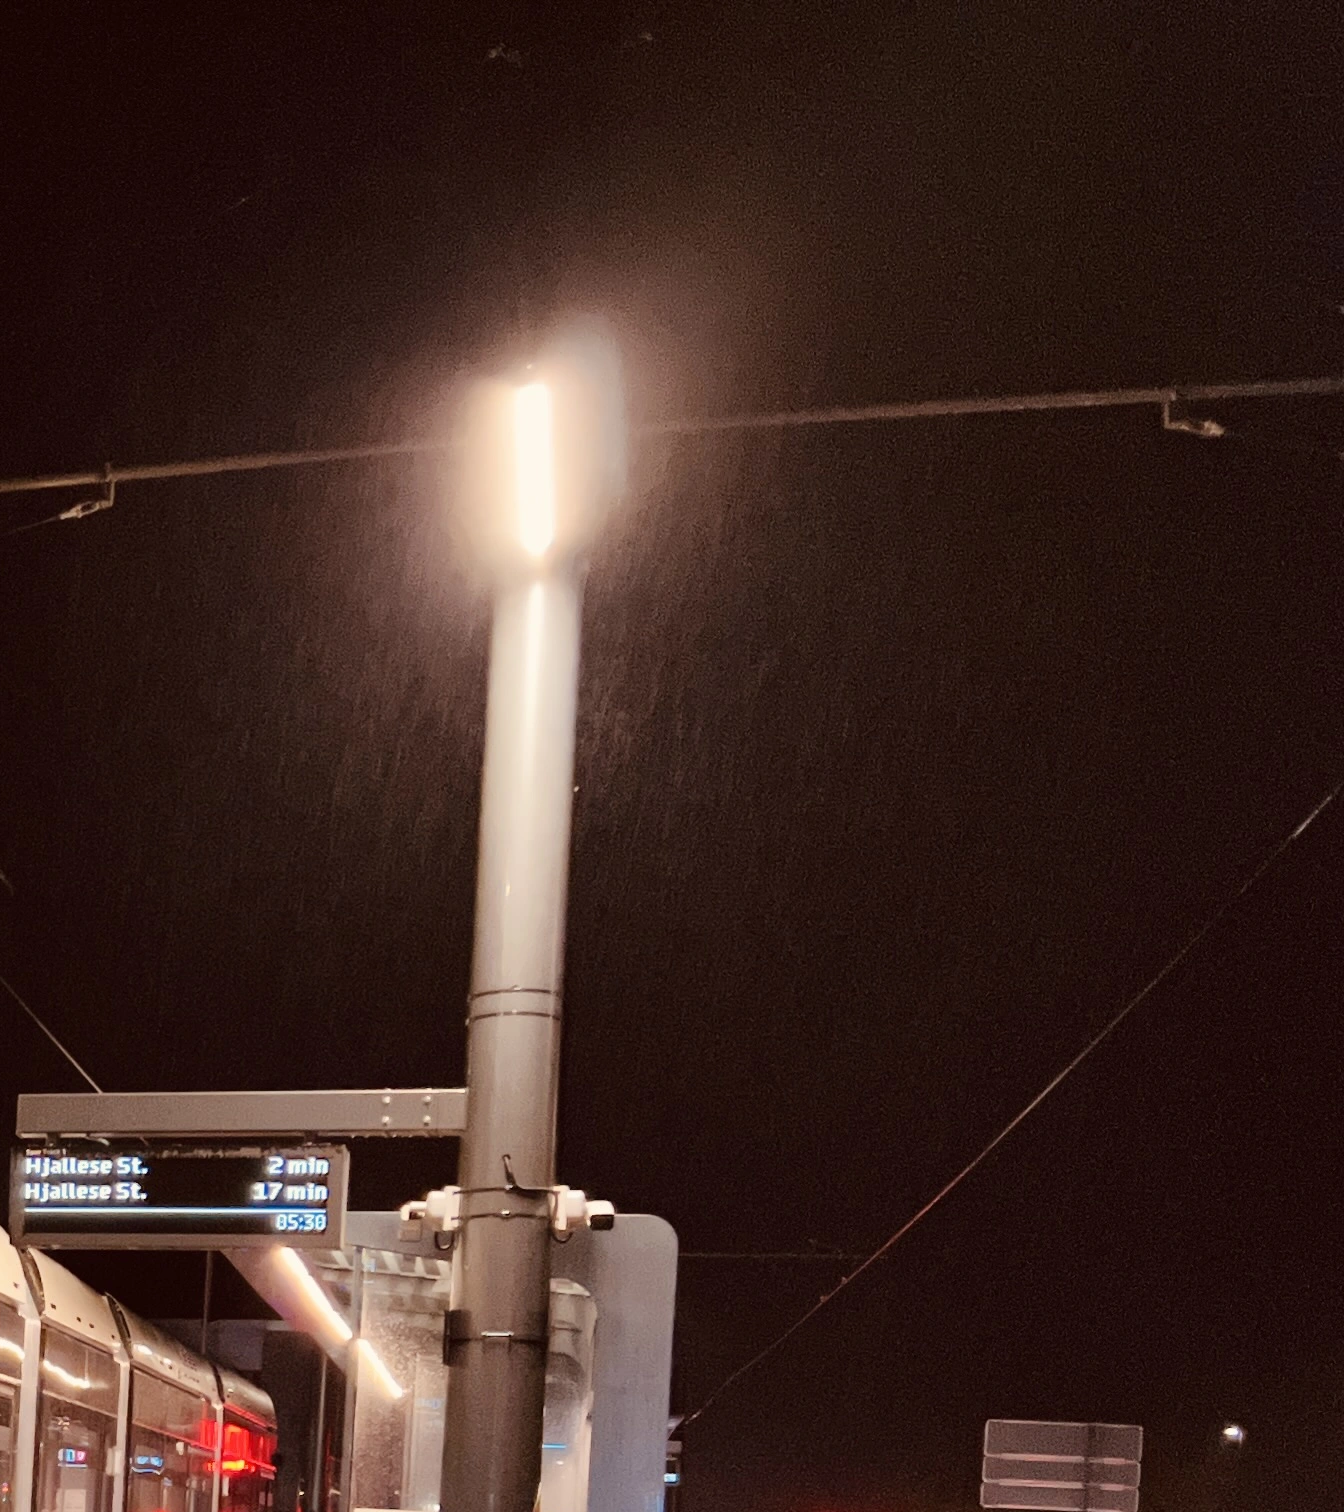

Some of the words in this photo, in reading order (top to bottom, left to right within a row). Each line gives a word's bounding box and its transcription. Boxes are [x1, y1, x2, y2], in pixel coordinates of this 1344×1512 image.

[24, 1156, 113, 1179] Hjallese
[117, 1156, 149, 1175] St.
[267, 1156, 284, 1174] 2
[287, 1156, 330, 1175] min
[23, 1182, 111, 1204] Hjallese
[115, 1182, 148, 1201] St.
[252, 1181, 284, 1201] 17
[286, 1182, 329, 1201] min
[275, 1213, 328, 1231] 05:30
